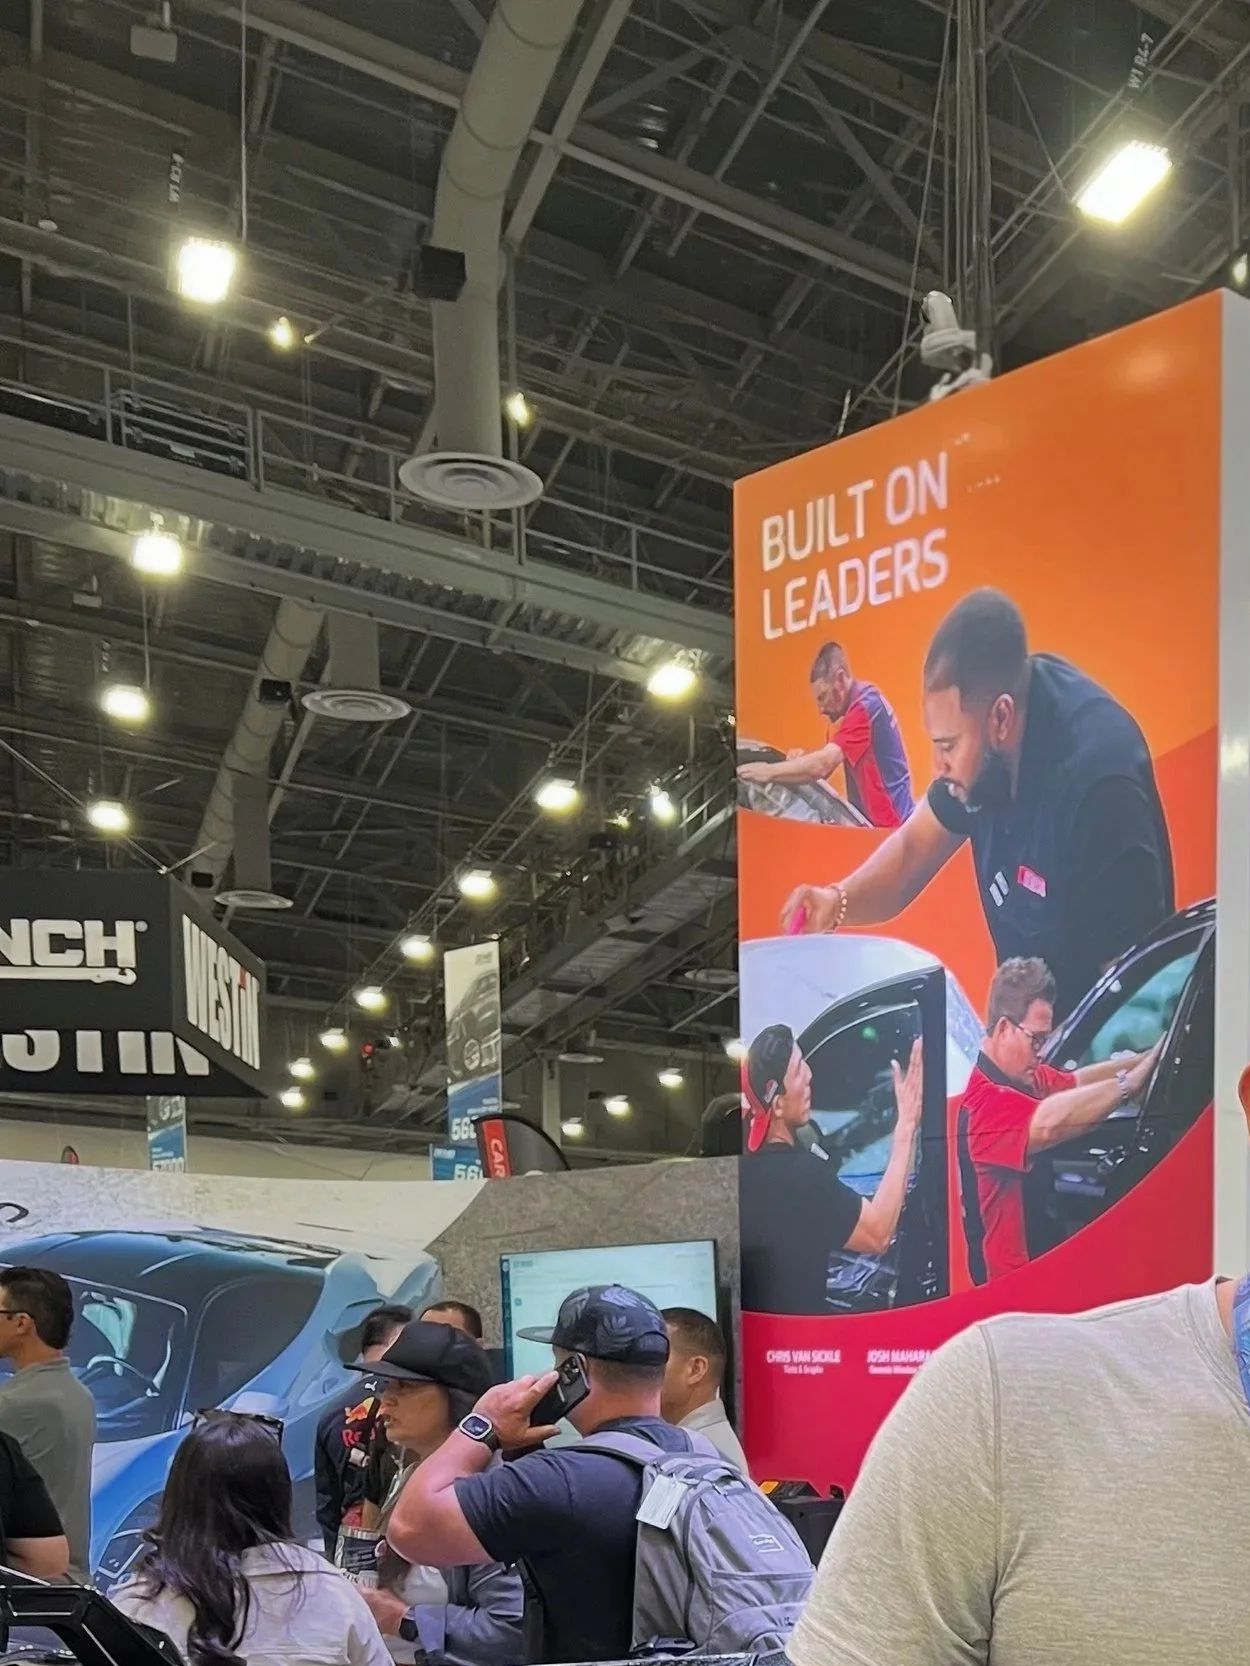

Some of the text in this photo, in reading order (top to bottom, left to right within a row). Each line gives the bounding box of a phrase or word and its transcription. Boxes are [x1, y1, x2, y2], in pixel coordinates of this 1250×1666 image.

[762, 479, 874, 572] BUILT
[885, 451, 948, 526] ON
[763, 528, 948, 640] LEADERS
[766, 1350, 790, 1364] CHRIS
